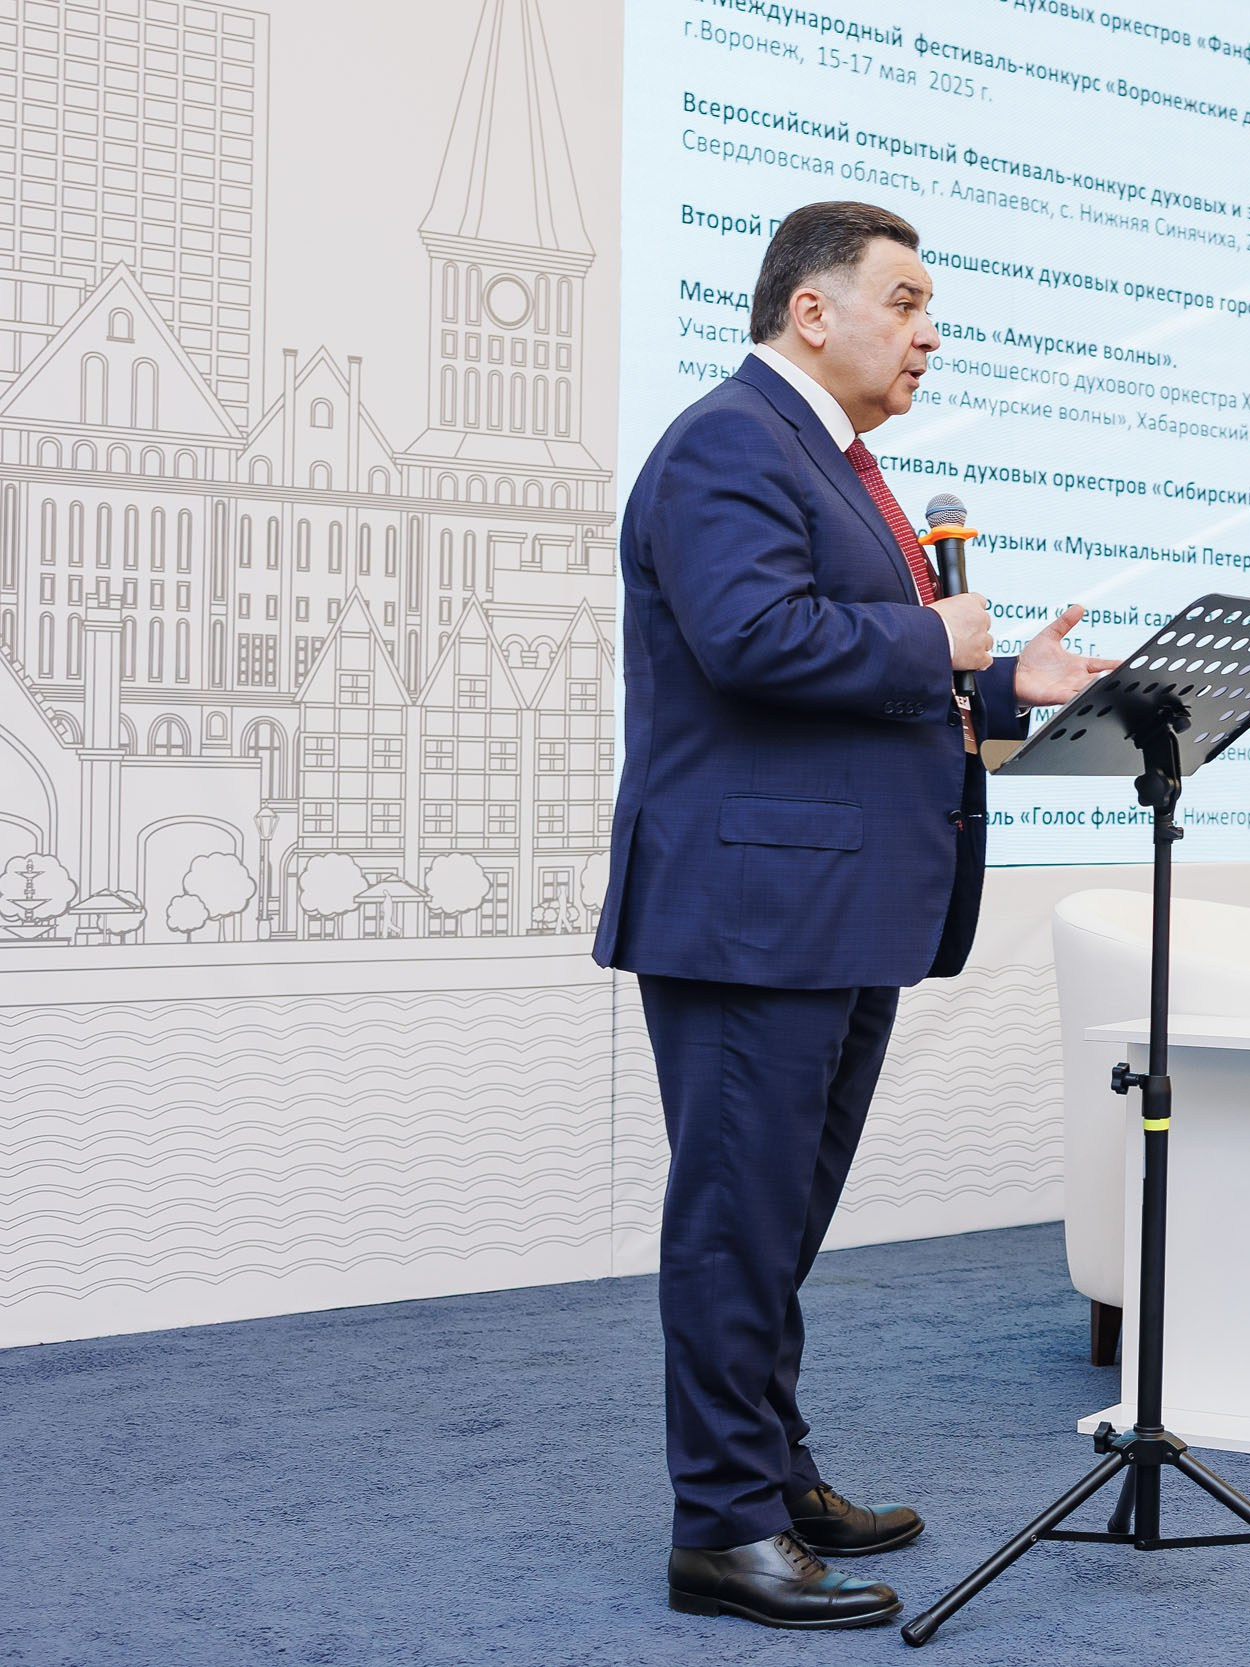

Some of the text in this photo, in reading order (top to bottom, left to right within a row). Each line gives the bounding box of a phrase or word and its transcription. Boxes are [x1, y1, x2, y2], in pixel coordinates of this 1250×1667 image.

[1014, 0, 1094, 24] духовых
[1100, 12, 1191, 47] оркестров
[685, 18, 992, 103] г.Воронеж, 15-17 мая 2025 г.
[914, 32, 1100, 93] фестиваль-конкурс
[1106, 78, 1238, 122] «Воронежские
[684, 91, 849, 143] Всероссийский
[856, 130, 957, 164] открытый
[963, 147, 1146, 202] Фестиваль-конкурс
[1151, 188, 1226, 215] духовых
[1232, 204, 1241, 218] и
[682, 128, 834, 176] Свердловская
[841, 159, 925, 196] область,
[932, 179, 943, 197] г.
[950, 179, 1054, 219] Алапаевск,
[1060, 203, 1074, 220] с.
[1080, 204, 1149, 232] Нижняя
[1155, 217, 1240, 252] Синячиха,
[682, 203, 761, 236] Второй
[1038, 268, 1118, 294] духовых
[1124, 281, 1214, 310] оркестров
[678, 316, 753, 345] Участи
[1074, 374, 1155, 398] духового
[1160, 385, 1237, 411] оркестра
[992, 327, 1098, 358] «Амурские
[1104, 344, 1177, 368] волны».
[948, 390, 1052, 419] «Амурские
[1059, 406, 1131, 431] волны»,
[1137, 412, 1249, 441] Хабаровский
[964, 464, 1047, 485] духовых
[1053, 472, 1146, 497] оркестров
[1053, 535, 1196, 564] «Музыкальный
[1020, 806, 1085, 826] «Голос
